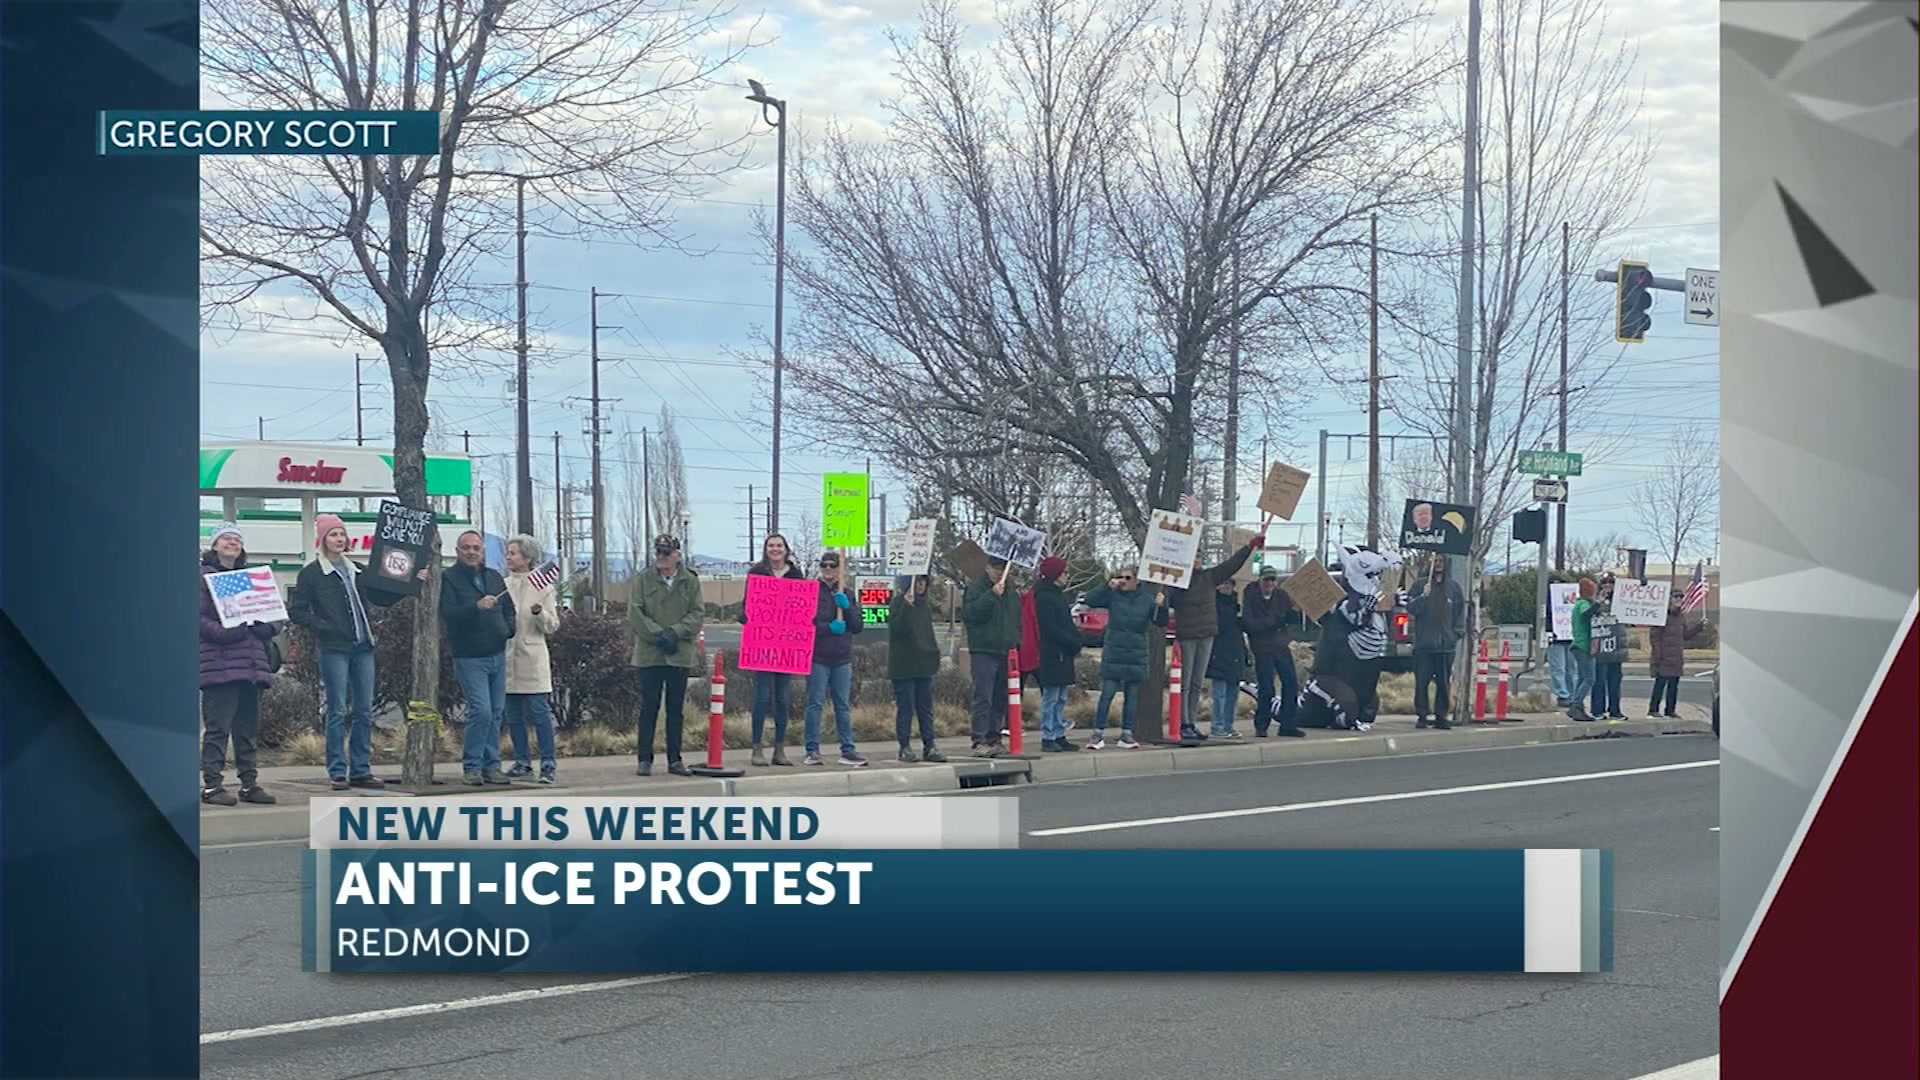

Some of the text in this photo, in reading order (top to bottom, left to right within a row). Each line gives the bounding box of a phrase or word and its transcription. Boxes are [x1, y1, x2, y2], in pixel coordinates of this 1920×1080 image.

[1691, 275, 1715, 289] ONE
[1690, 291, 1715, 304] WAY
[1404, 529, 1446, 545] Donald
[889, 552, 905, 565] 25
[752, 577, 779, 592] THIS
[1619, 583, 1666, 600] IMPEACH
[751, 592, 778, 607] JUST
[741, 647, 812, 669] HUMANITY
